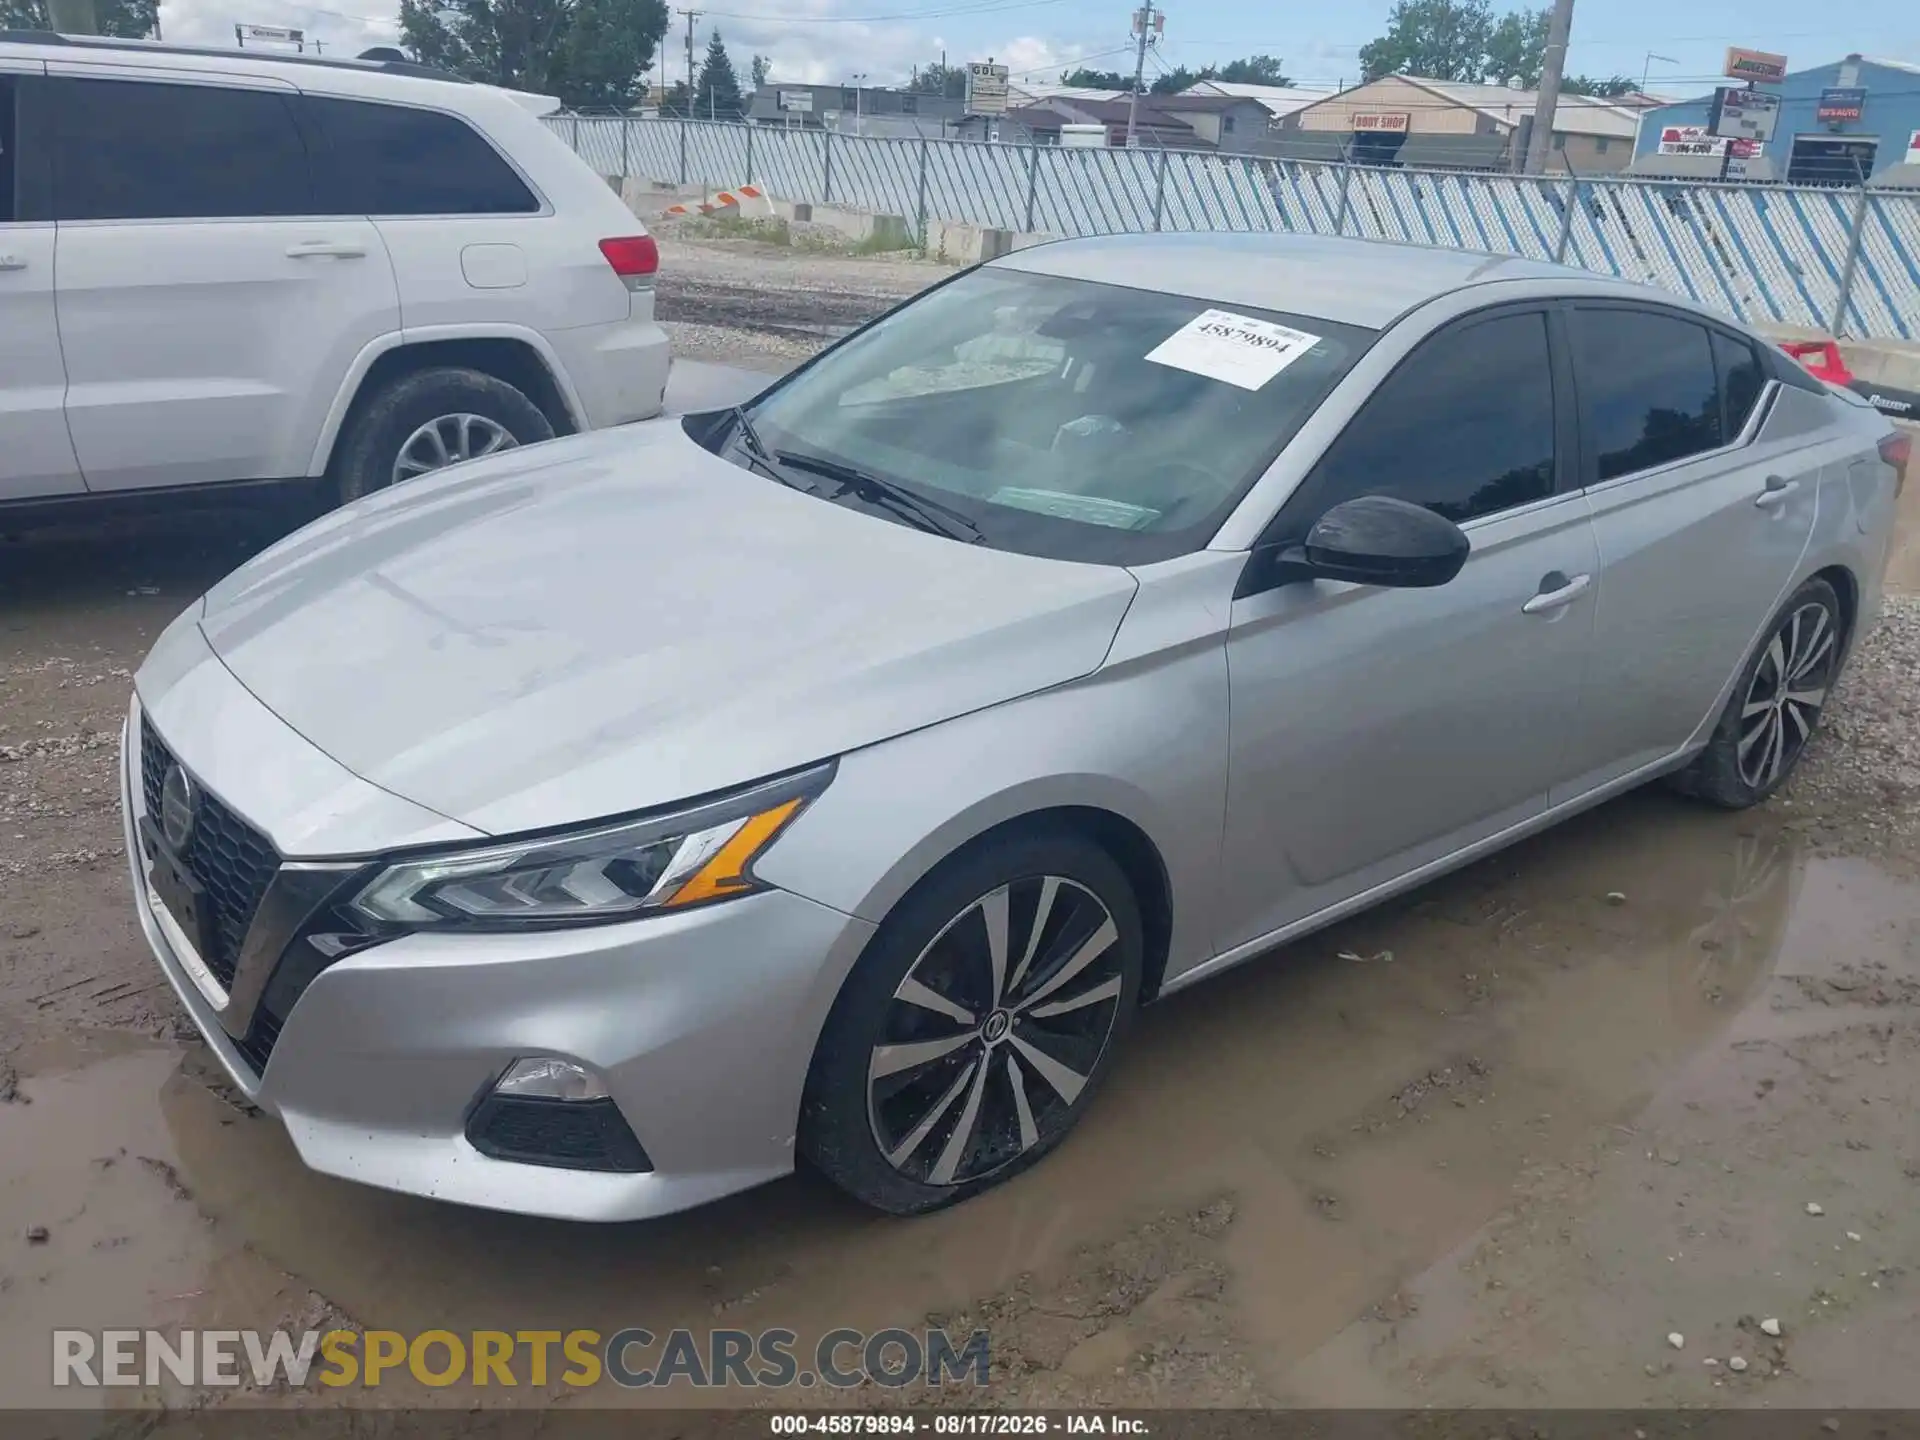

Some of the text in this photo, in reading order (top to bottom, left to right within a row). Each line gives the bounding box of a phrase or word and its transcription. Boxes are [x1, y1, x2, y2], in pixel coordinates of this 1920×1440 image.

[1355, 115, 1405, 128] BODY SHOP
[1198, 322, 1291, 354] 45879894
